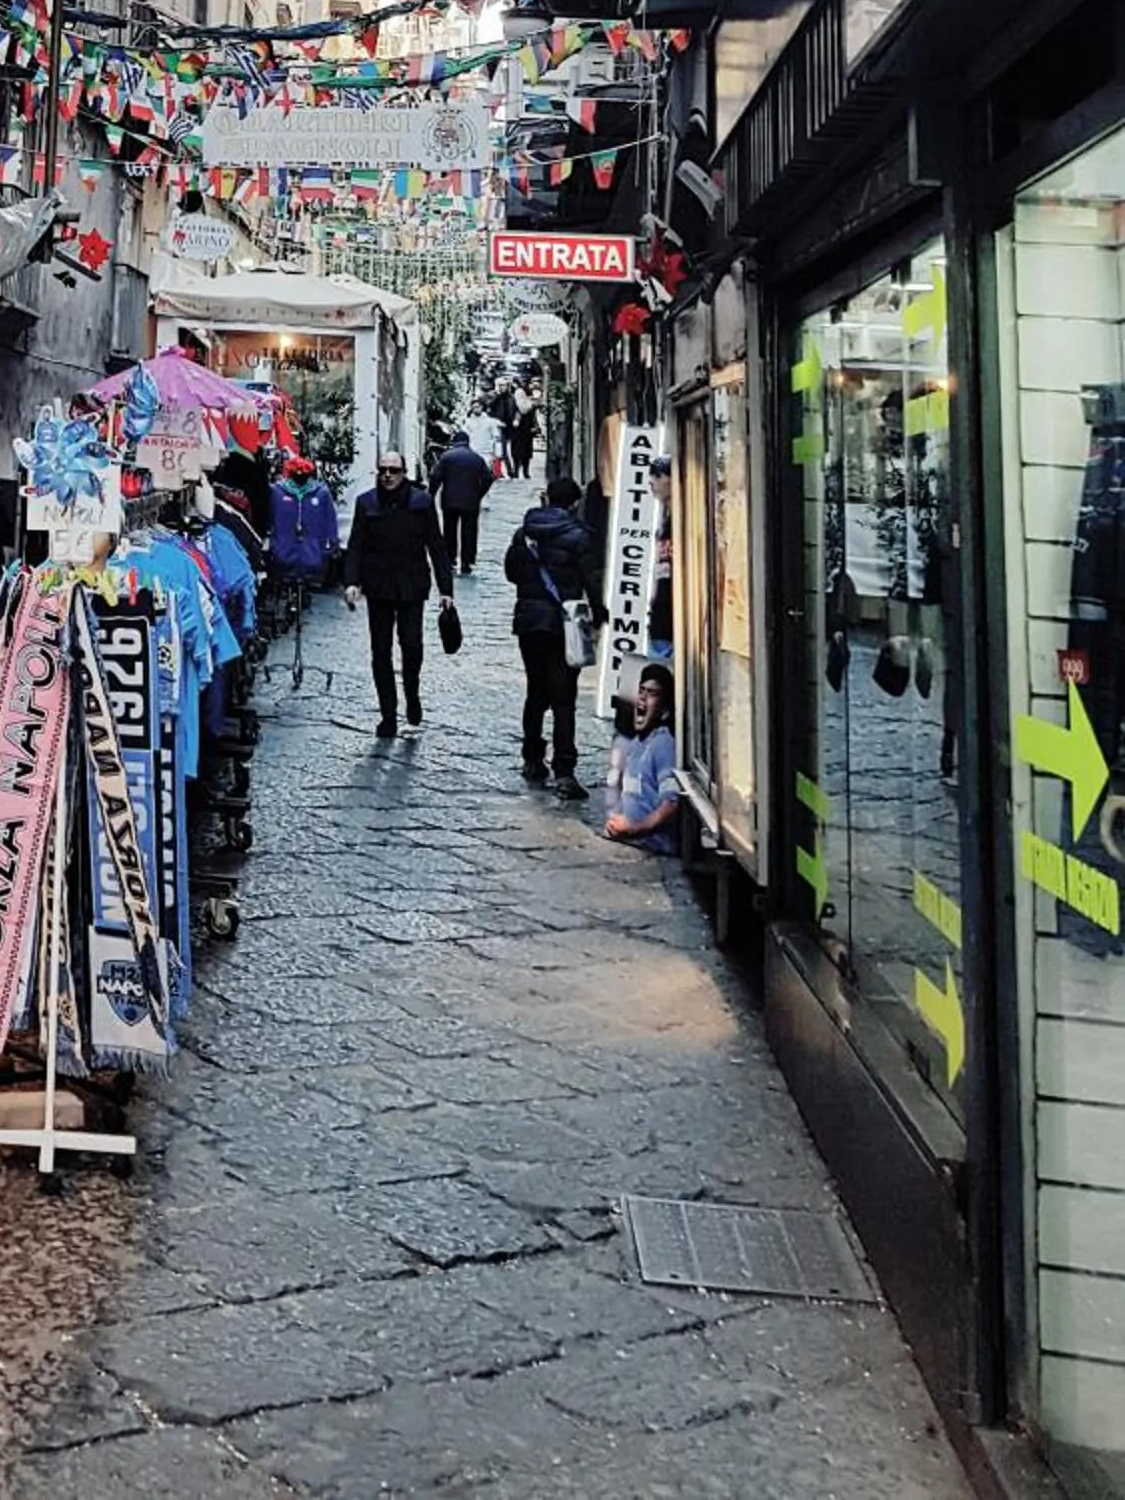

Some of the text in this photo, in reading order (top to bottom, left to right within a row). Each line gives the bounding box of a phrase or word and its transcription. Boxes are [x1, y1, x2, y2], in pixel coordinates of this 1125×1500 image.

[498, 241, 624, 271] ENTRATA
[627, 435, 651, 521] ABITI
[620, 527, 650, 539] PER
